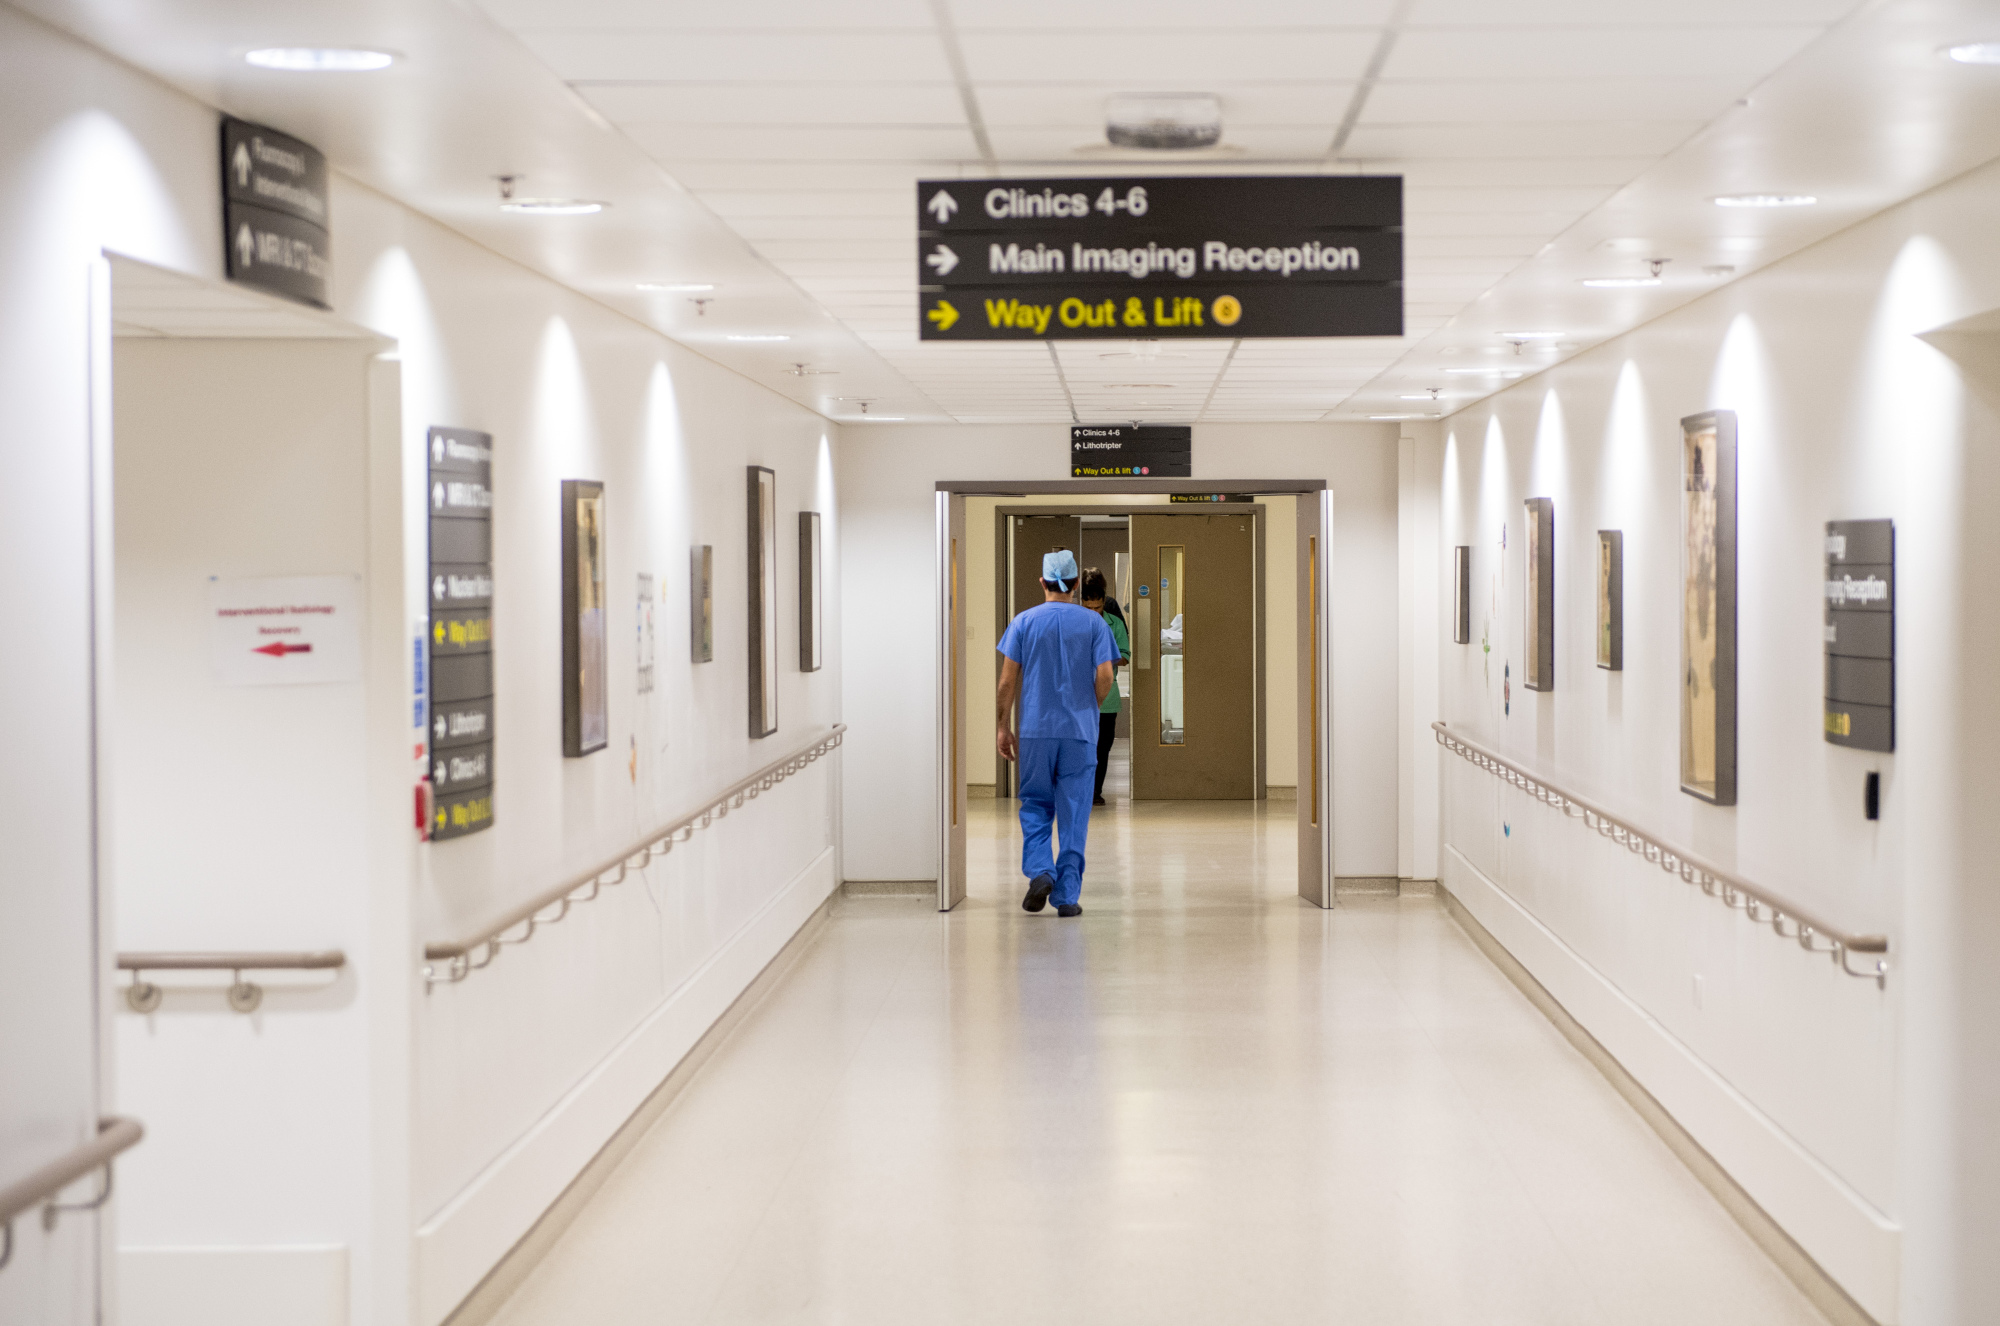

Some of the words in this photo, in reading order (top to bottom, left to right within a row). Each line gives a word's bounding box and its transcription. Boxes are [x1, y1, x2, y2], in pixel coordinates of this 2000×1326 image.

[984, 186, 1089, 219] Clinics
[1095, 186, 1149, 217] 4-6
[989, 242, 1065, 274] Main
[1072, 241, 1196, 279] Imaging
[1203, 240, 1360, 278] Reception
[984, 297, 1053, 334] Way
[1058, 296, 1116, 328] Out
[1122, 296, 1147, 328] &
[1153, 296, 1204, 328] Lift
[1082, 428, 1107, 437] Clinics
[1107, 428, 1121, 437] 4-6
[1082, 441, 1122, 450] Lithotripter
[1083, 467, 1099, 476] Way
[1100, 467, 1114, 475] Out
[1115, 467, 1121, 475] &
